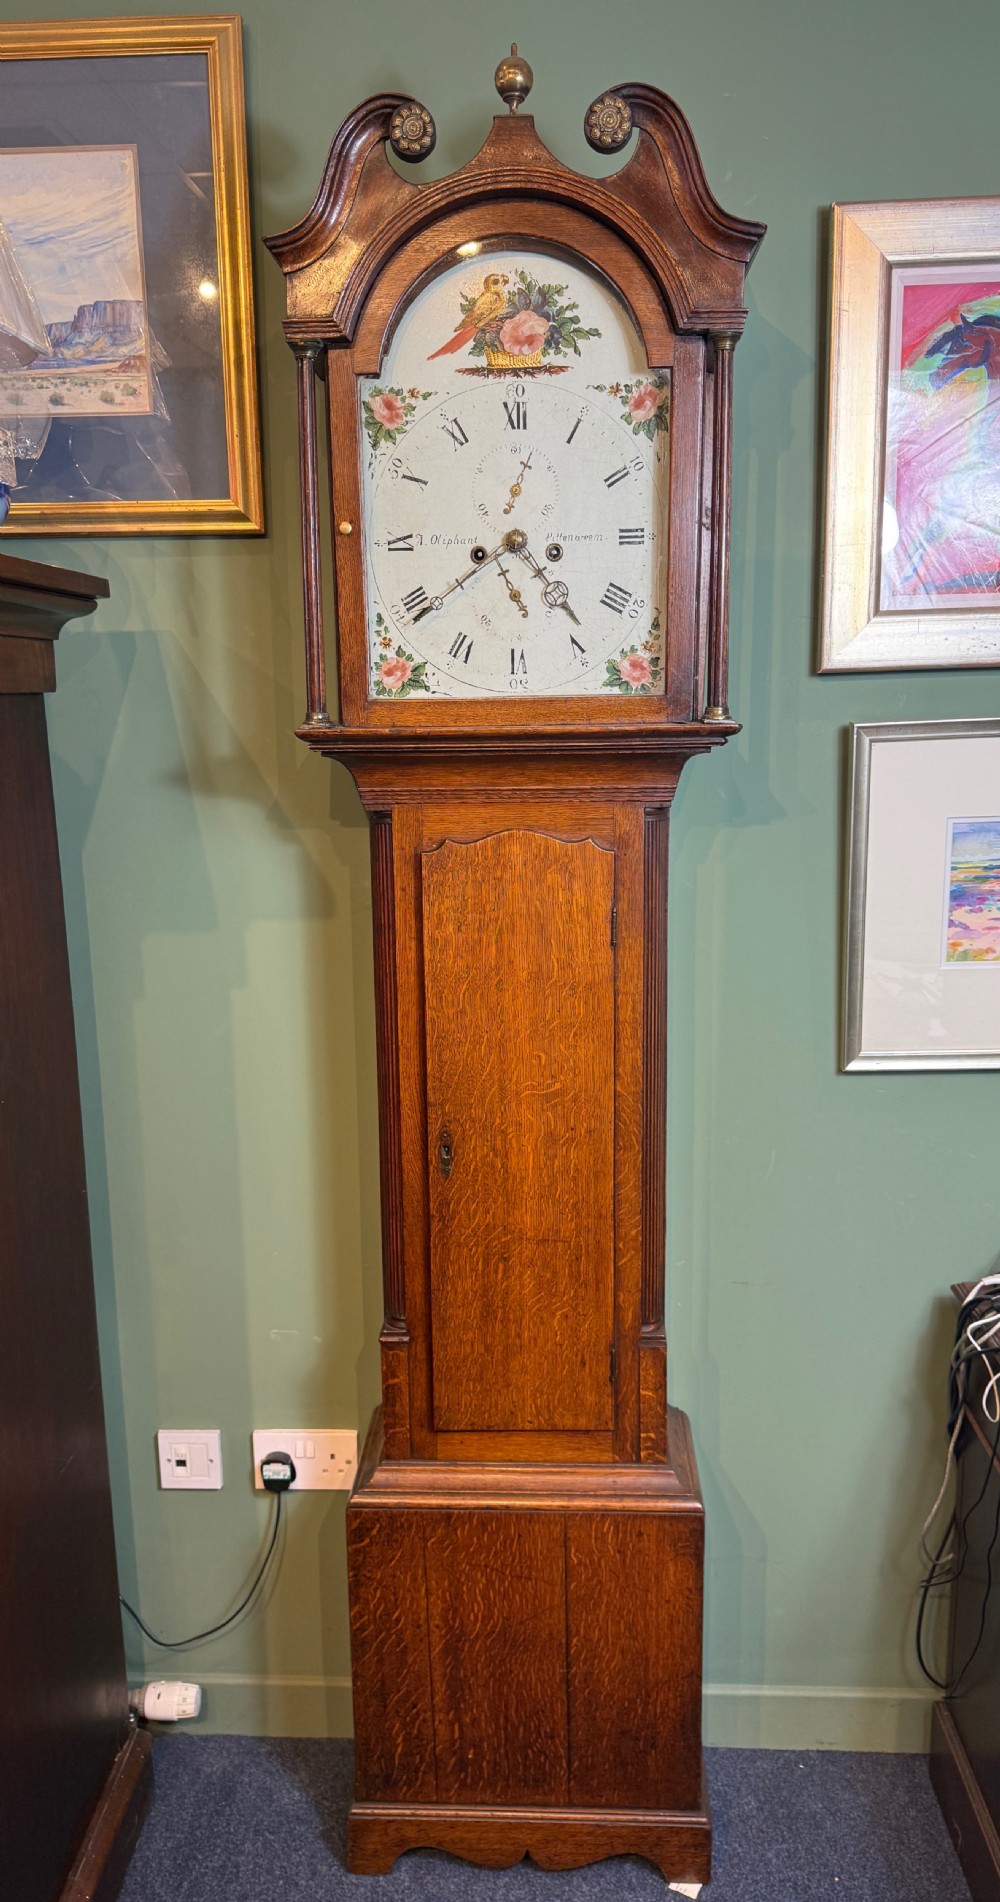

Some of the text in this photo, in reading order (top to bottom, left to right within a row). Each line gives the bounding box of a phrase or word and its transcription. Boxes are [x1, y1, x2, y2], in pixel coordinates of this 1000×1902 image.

[506, 383, 525, 398] 60
[502, 401, 528, 431] XII
[441, 416, 469, 453] XI
[566, 416, 583, 445] I
[387, 457, 403, 480] 50
[603, 462, 631, 491] II
[629, 455, 645, 472] 10
[401, 465, 429, 493] X
[387, 531, 414, 552] IX
[430, 532, 479, 550] Oliphant
[618, 527, 645, 546] III
[600, 580, 632, 614] IIII
[628, 598, 646, 619] 20
[447, 631, 474, 665] VII
[569, 633, 586, 659] V
[509, 648, 528, 676] VI
